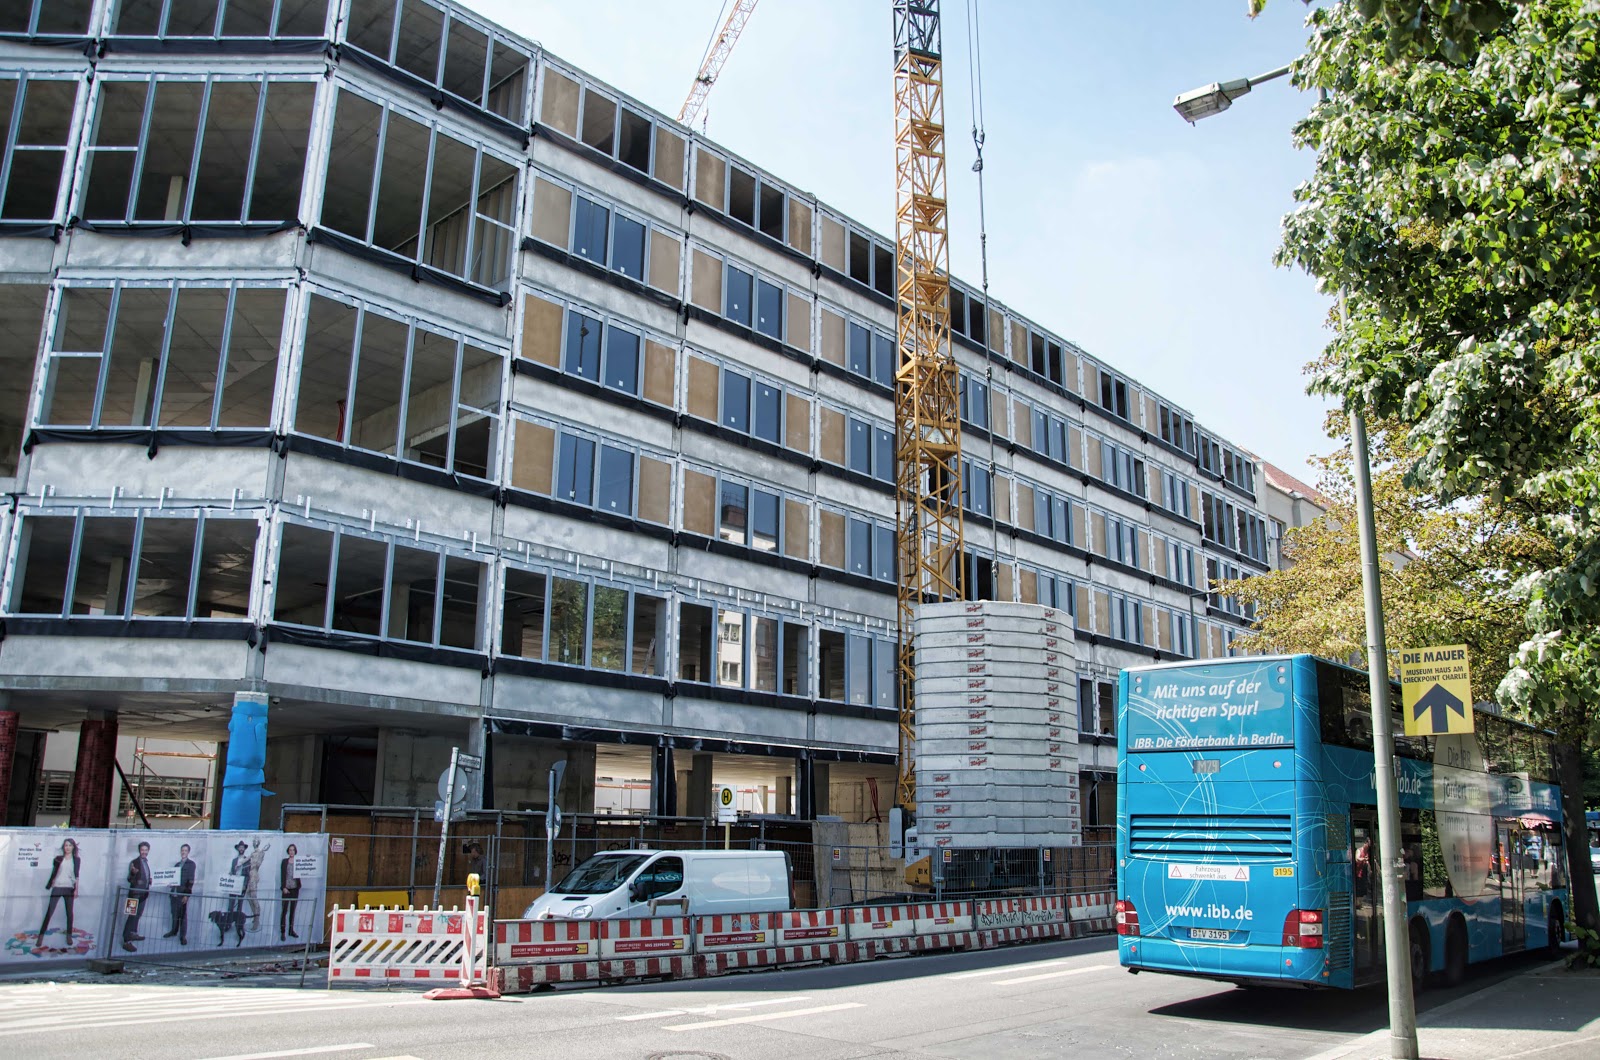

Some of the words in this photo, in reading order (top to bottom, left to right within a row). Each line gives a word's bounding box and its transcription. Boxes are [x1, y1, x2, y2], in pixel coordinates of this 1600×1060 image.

[1403, 652, 1421, 664] DIE
[1424, 650, 1466, 663] MAUER
[1406, 668, 1433, 676] MUSEUM
[1435, 666, 1451, 674] HAUS
[1403, 675, 1440, 684] CHECKPOINT
[1442, 673, 1468, 681] CHARLIE
[1153, 684, 1178, 699] Mit
[1181, 686, 1206, 697] uns
[1208, 680, 1234, 700] auf
[1236, 679, 1261, 694] der
[1156, 705, 1217, 722] richtigen
[1220, 701, 1259, 720] Spur!
[1134, 738, 1155, 749] IBB:
[1156, 737, 1173, 748] Die
[1175, 734, 1236, 748] Förderbank
[1237, 735, 1249, 745] in
[1251, 733, 1285, 745] Berlin
[1197, 761, 1219, 772] M29
[1195, 865, 1221, 875] Fahrzeug
[1274, 867, 1293, 876] 3195
[1165, 904, 1254, 920] www.ibb.de
[1192, 929, 1197, 937] B
[1208, 930, 1228, 939] 3195
